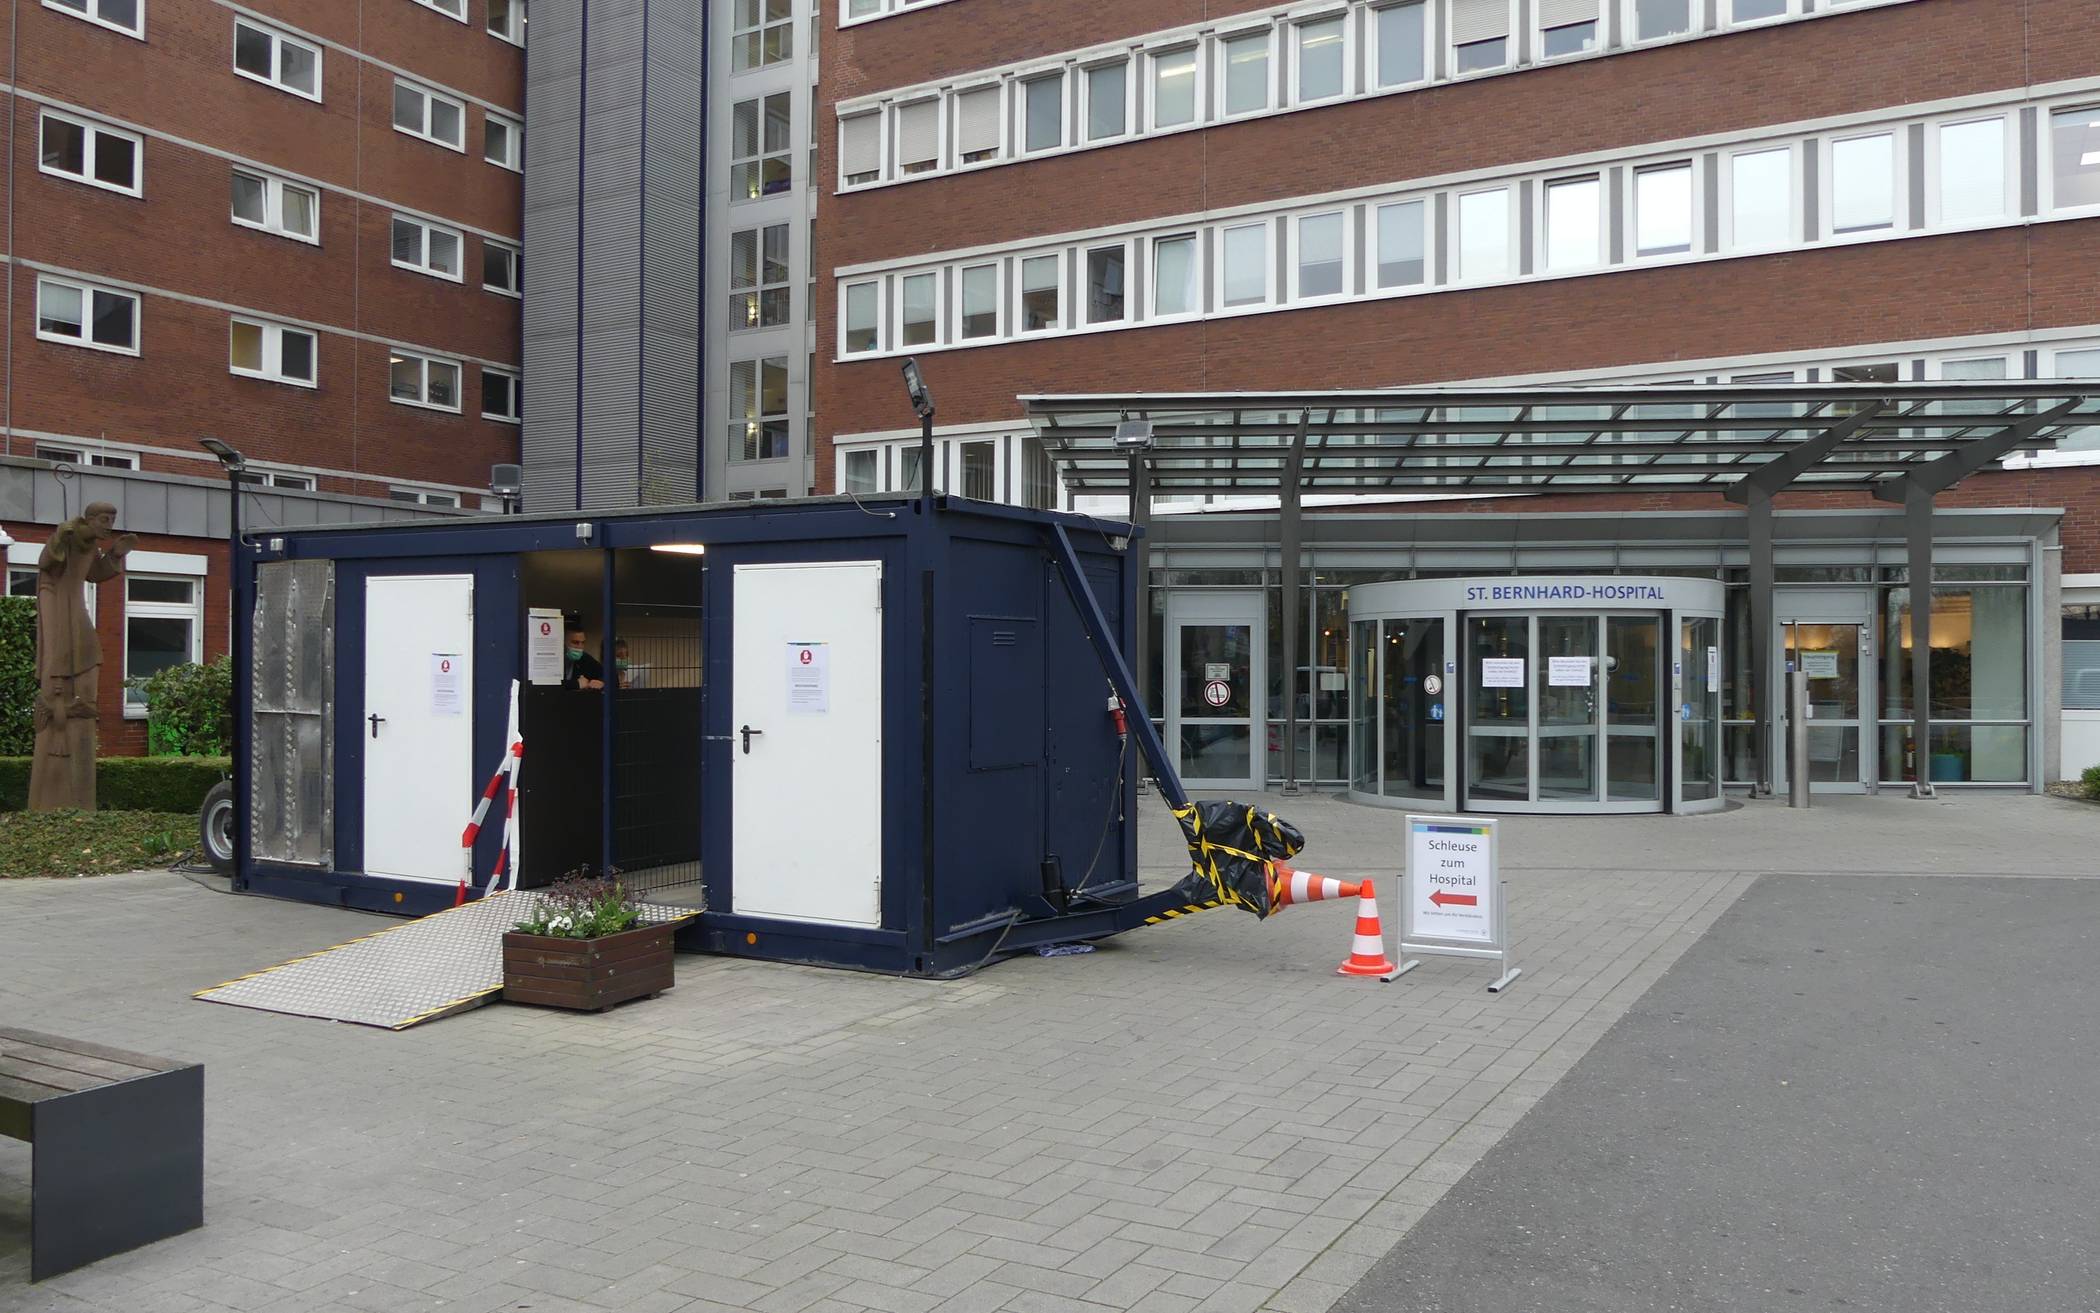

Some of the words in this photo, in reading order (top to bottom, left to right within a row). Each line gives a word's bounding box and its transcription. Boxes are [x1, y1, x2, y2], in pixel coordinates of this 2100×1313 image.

[1467, 587, 1488, 600] ST.
[1492, 585, 1664, 600] BERNHARD-HOSPITAL
[1428, 839, 1478, 852] Schleuse
[1440, 859, 1465, 868] zum
[1429, 873, 1476, 887] Hospital
